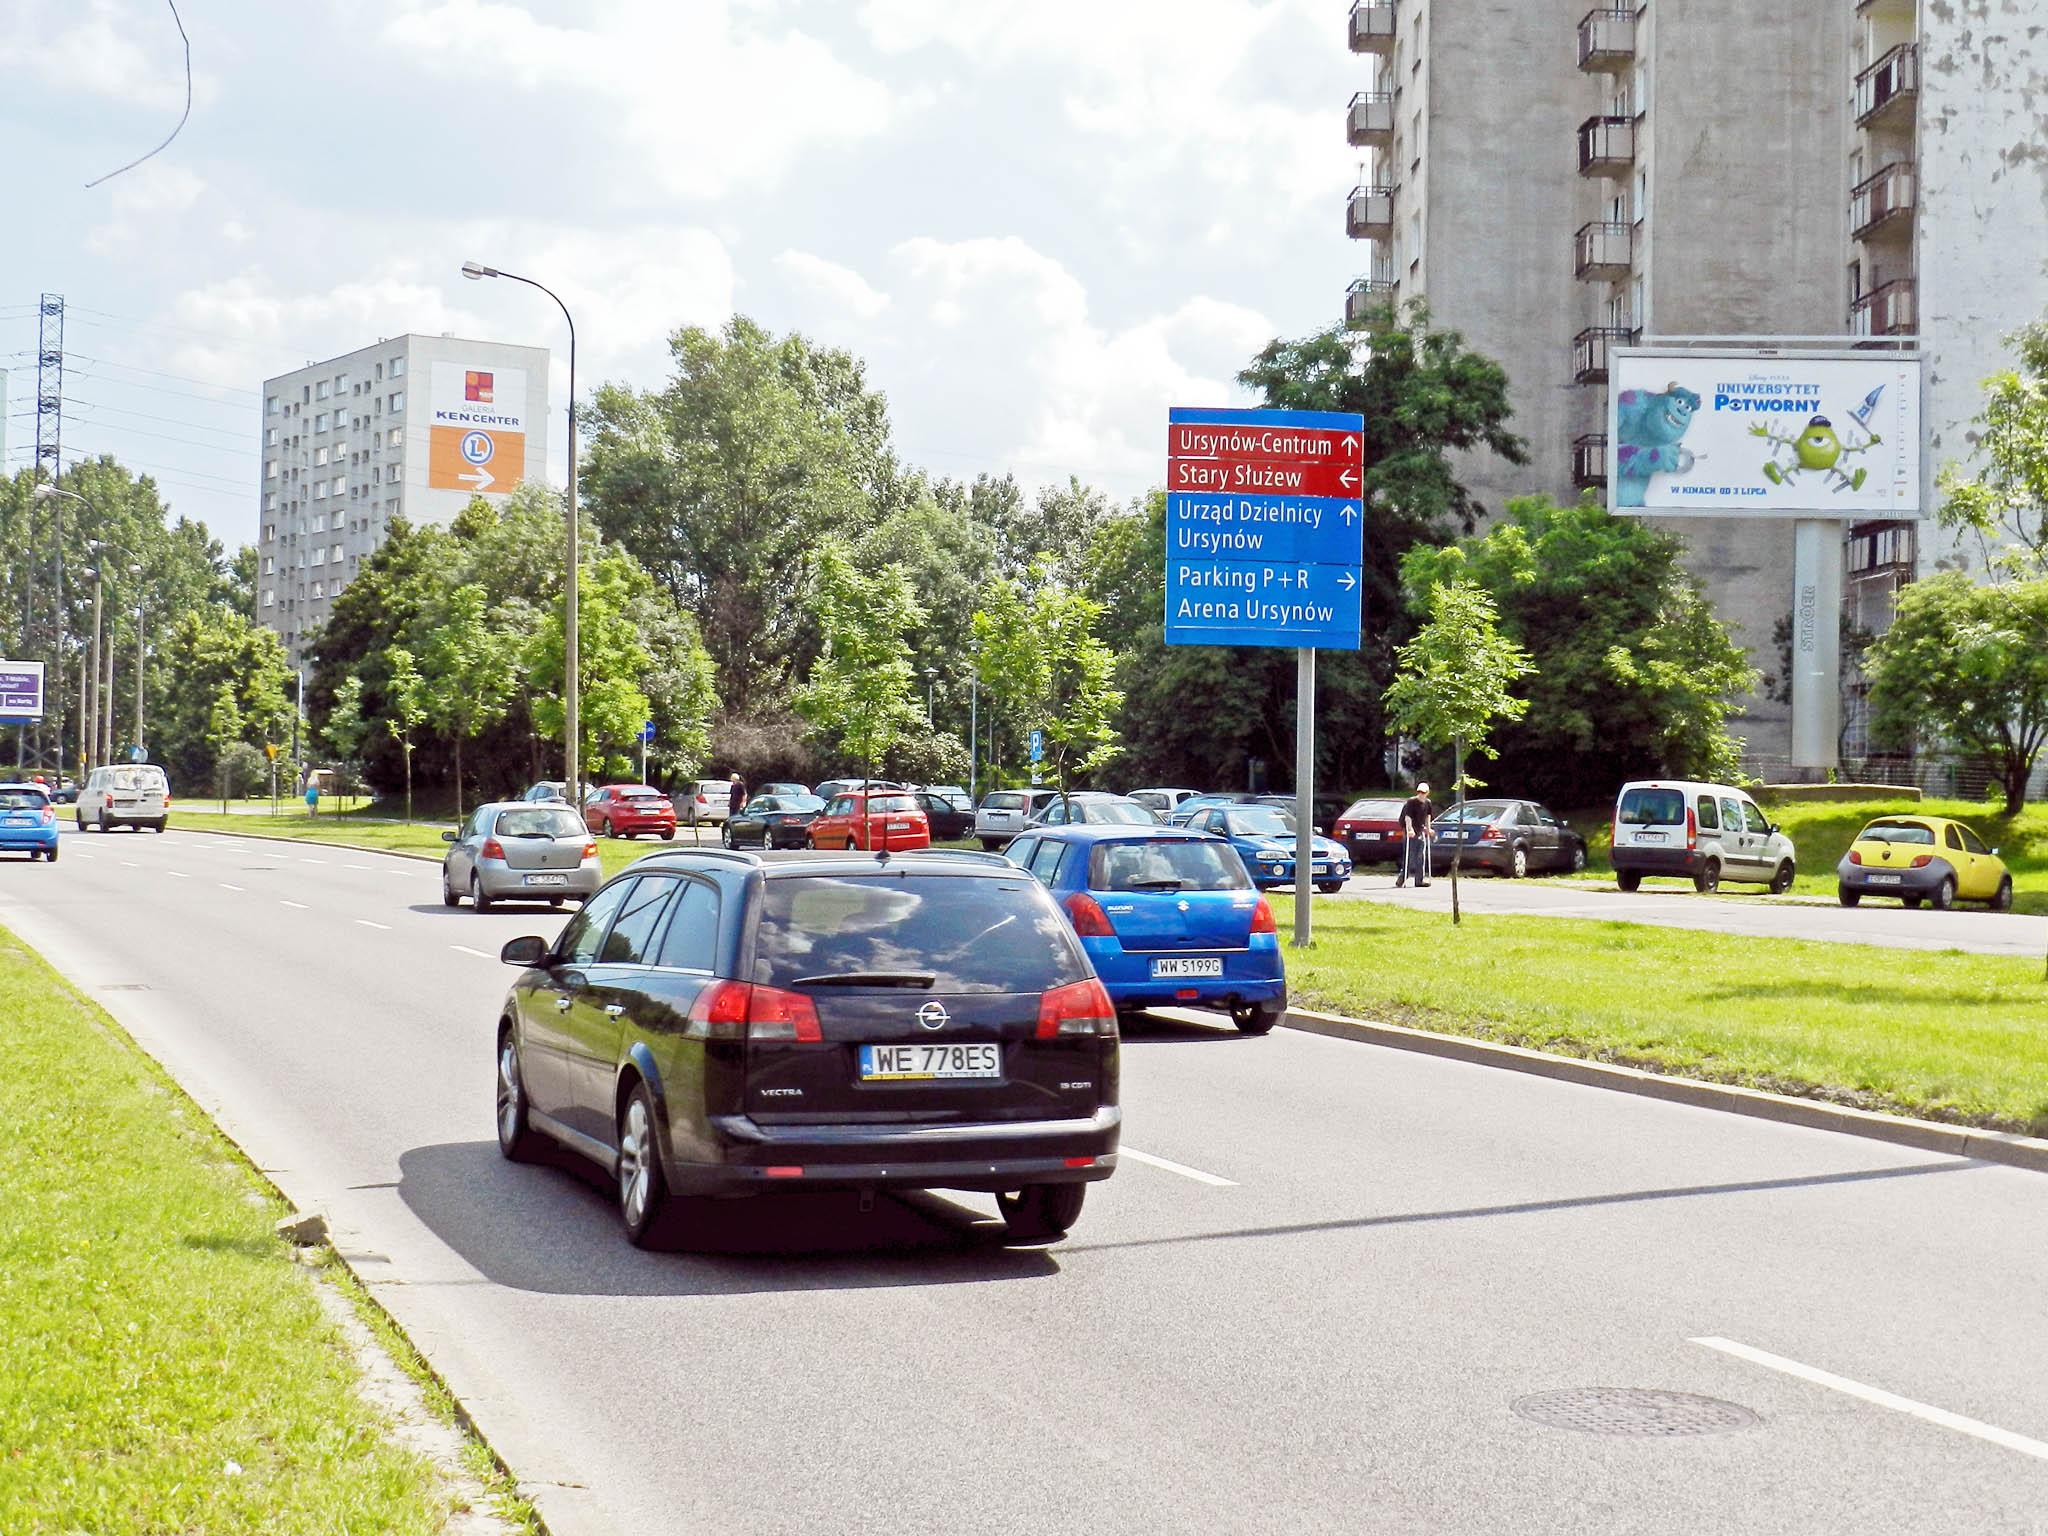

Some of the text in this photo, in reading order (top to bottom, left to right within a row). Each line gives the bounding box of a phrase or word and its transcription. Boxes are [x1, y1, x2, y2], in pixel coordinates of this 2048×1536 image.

[1716, 383, 1821, 395] UNIWERSYTET
[436, 410, 520, 426] KEN CENTER
[462, 405, 495, 413] GALERIA
[1180, 430, 1332, 455] Ursynów-Centrum
[1179, 463, 1302, 489] Stary Służew
[1671, 486, 1767, 496] W KINACH OD 3 LIPCA
[1178, 499, 1322, 528] Urząd Dzielnicy
[1178, 528, 1263, 553] Ursynów
[1179, 566, 1256, 592] Parking
[1177, 598, 1333, 625] Arena Ursynów
[1033, 734, 1039, 751] P
[1160, 959, 1220, 973] WW 5199G
[877, 1047, 912, 1072] WE
[921, 1046, 996, 1071] 778ES
[761, 1088, 803, 1096] VECTRA
